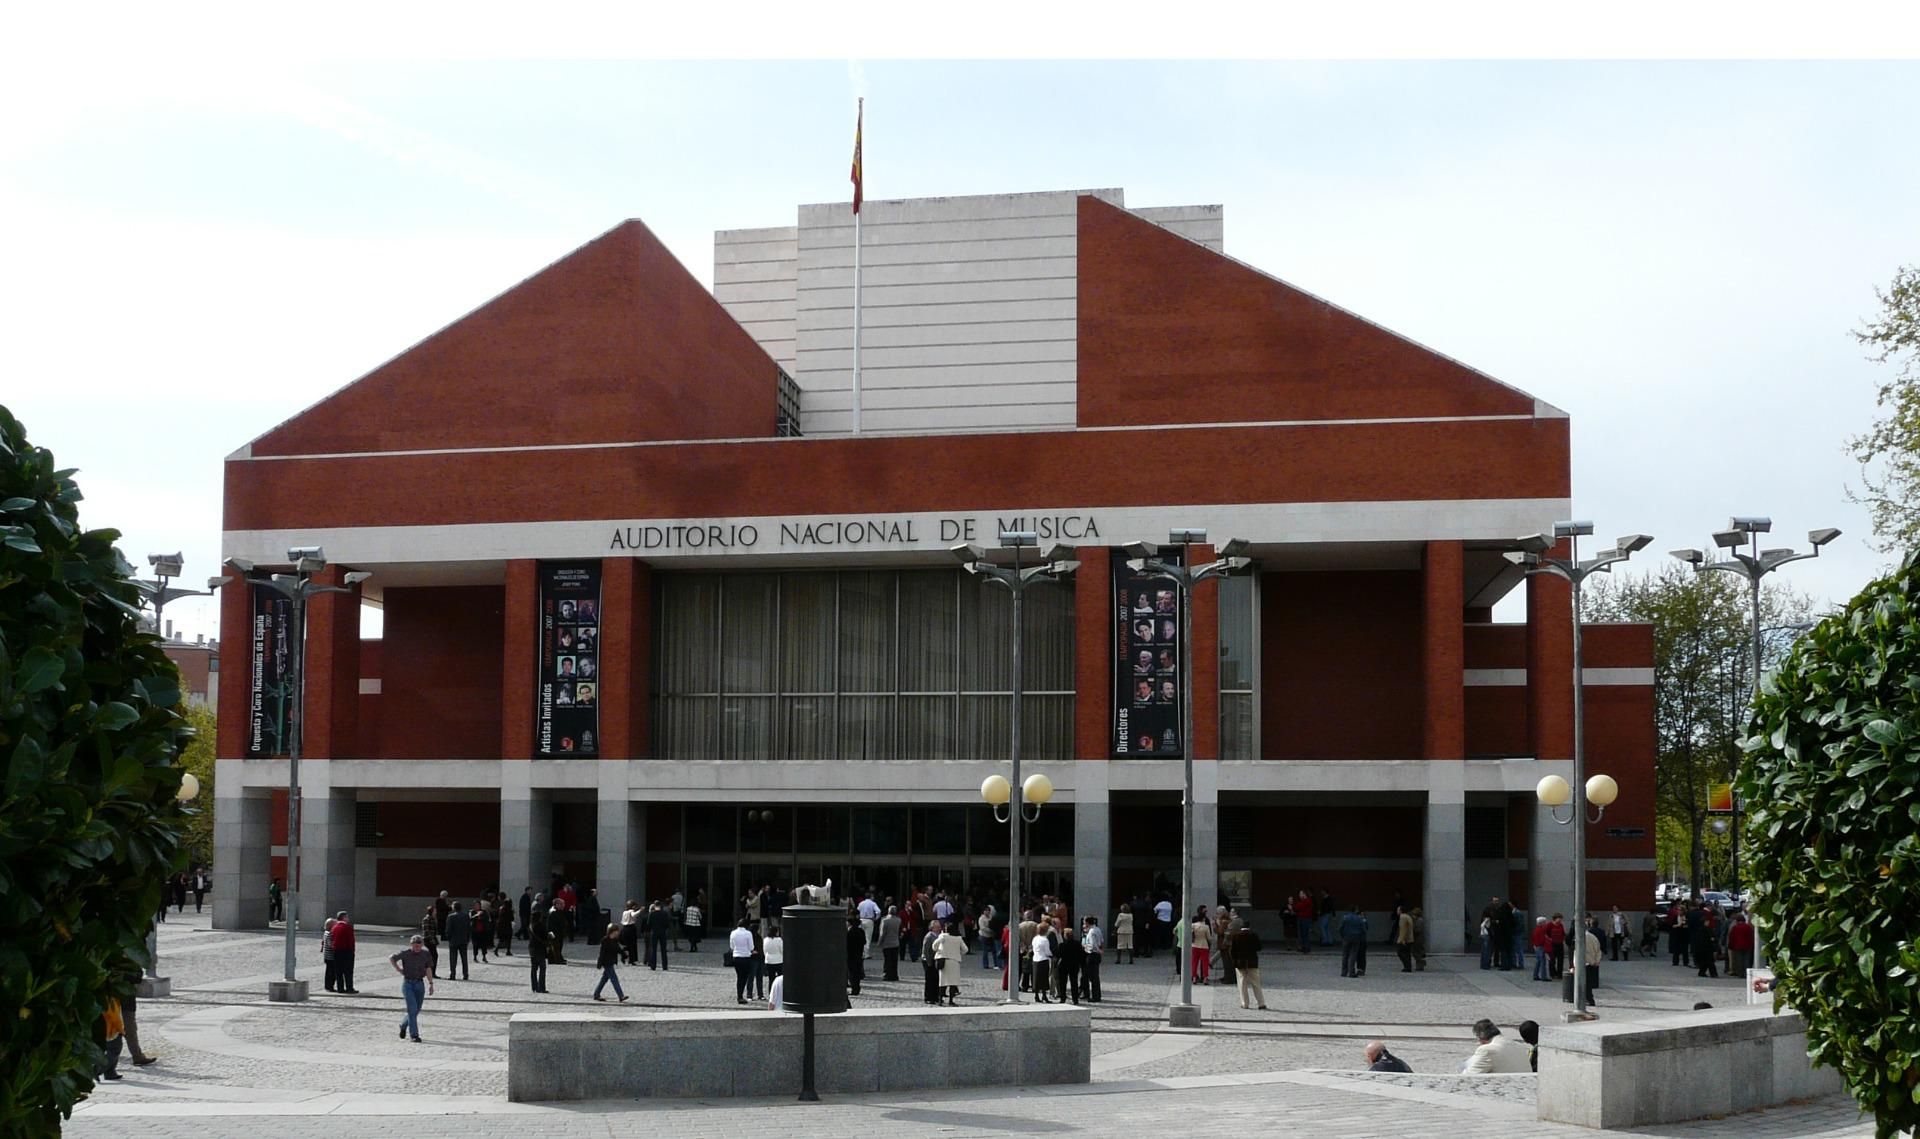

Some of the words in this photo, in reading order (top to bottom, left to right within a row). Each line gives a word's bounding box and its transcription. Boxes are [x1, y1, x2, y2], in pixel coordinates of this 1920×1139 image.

[610, 525, 758, 549] AUDITORIO
[780, 521, 918, 545] NACIONAL
[940, 519, 976, 541] DE
[997, 516, 1100, 540] MUSICA
[256, 615, 266, 641] España
[545, 615, 553, 629] 2007
[1120, 605, 1128, 621] 2007
[256, 642, 264, 651] de
[255, 653, 263, 692] Nacionales
[254, 693, 263, 711] Coro
[542, 683, 552, 719] Invitados
[252, 718, 263, 750] Orquesta
[541, 721, 551, 753] Artistas
[1117, 708, 1128, 753] Directores
